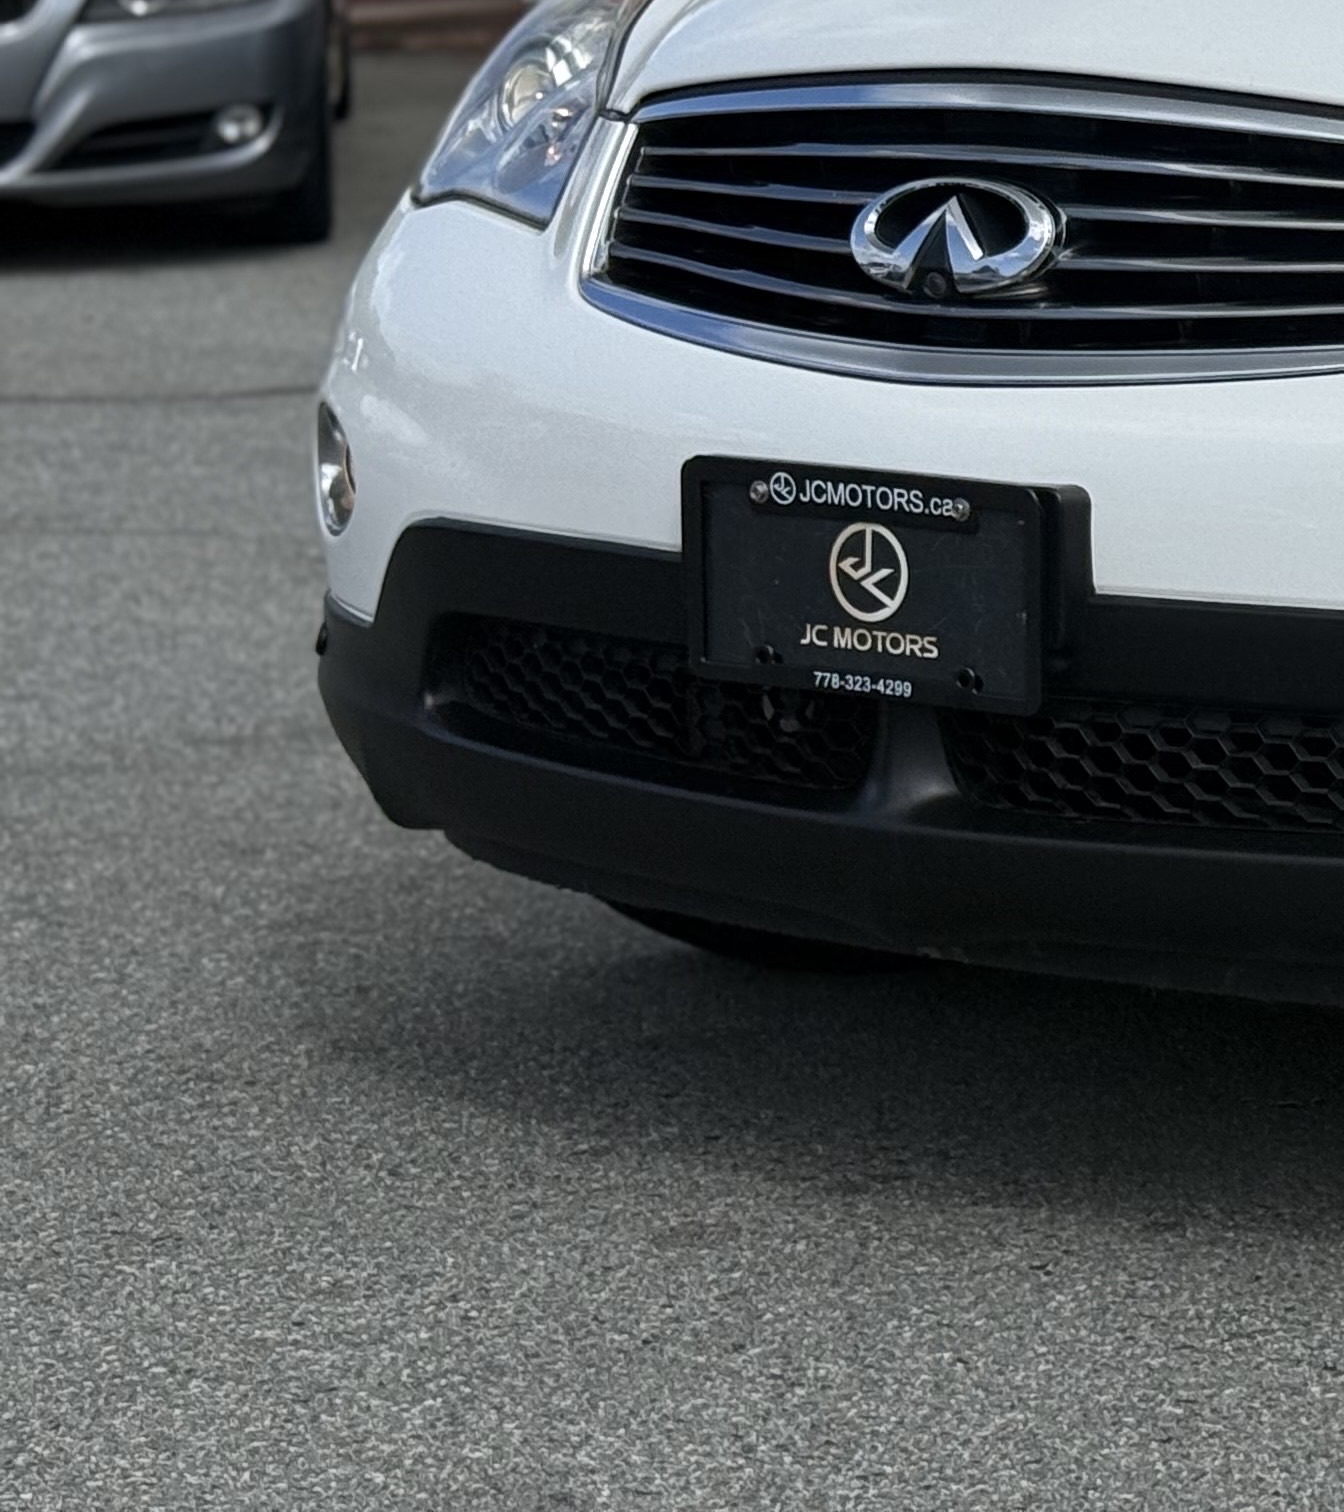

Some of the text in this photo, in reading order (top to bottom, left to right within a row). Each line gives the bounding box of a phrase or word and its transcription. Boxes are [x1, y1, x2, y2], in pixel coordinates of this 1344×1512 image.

[799, 479, 957, 517] JCMOTORS.ca
[800, 623, 940, 659] JC MOTORS
[813, 671, 912, 698] 778-323-4299
